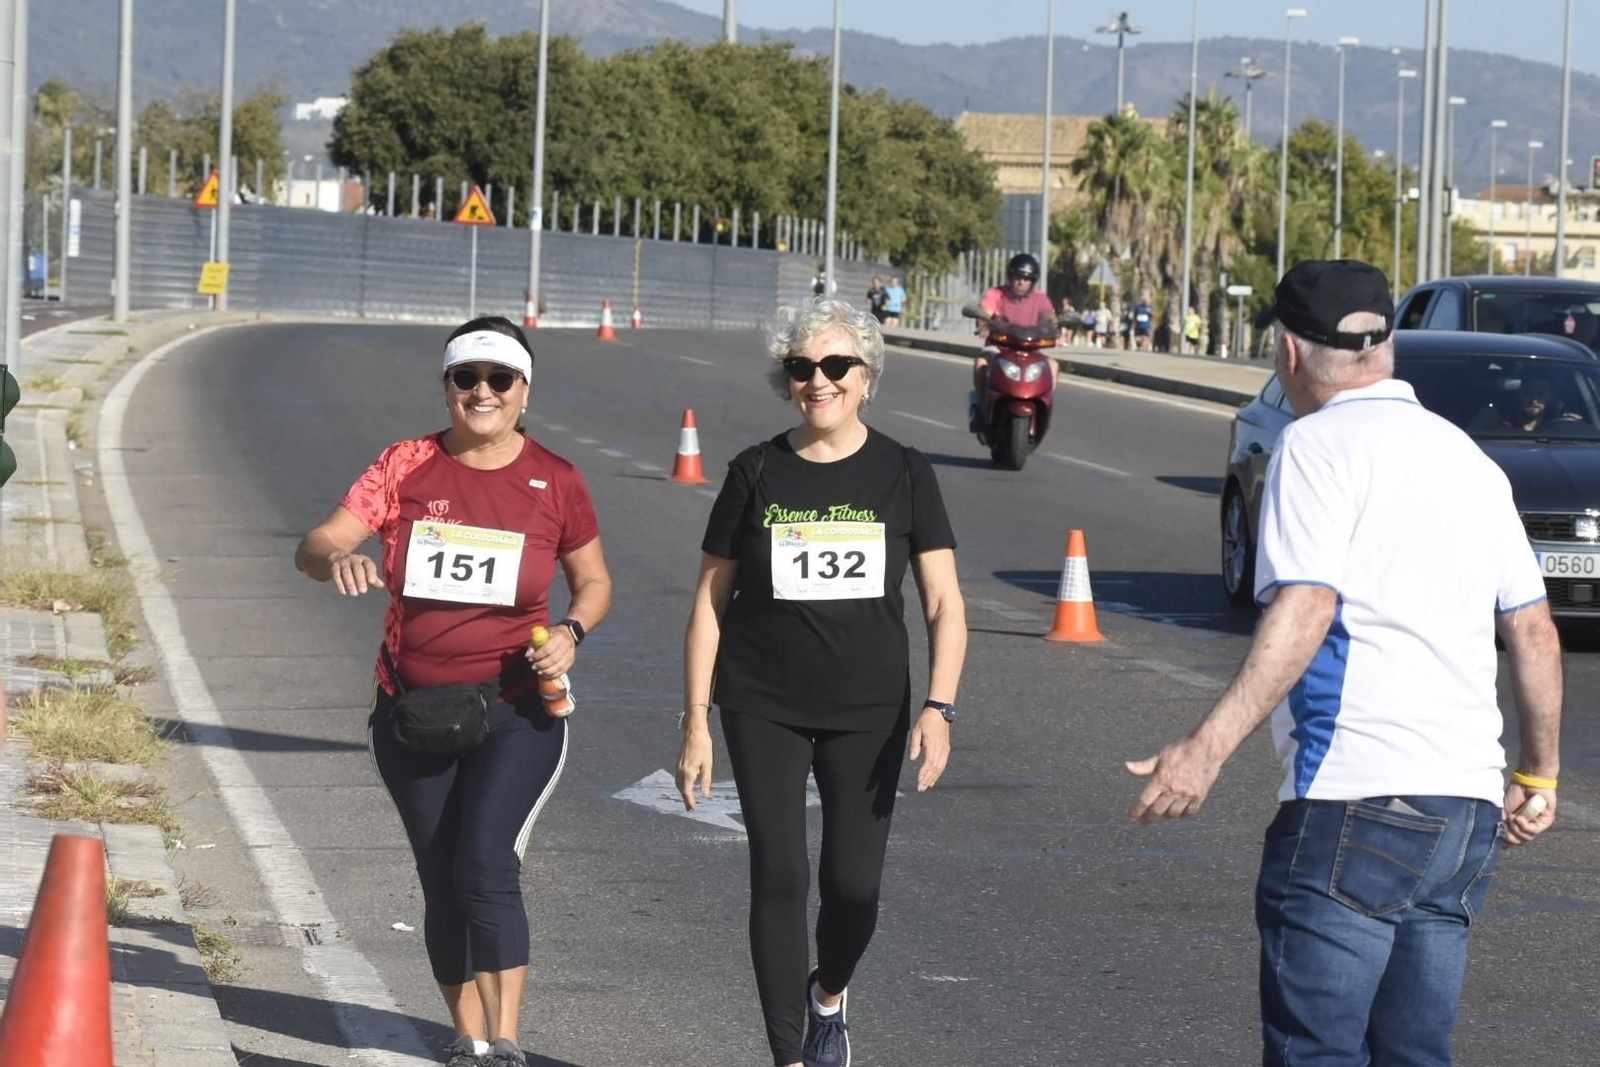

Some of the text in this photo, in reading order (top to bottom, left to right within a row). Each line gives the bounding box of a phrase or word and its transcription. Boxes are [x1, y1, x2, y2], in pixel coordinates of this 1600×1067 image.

[763, 503, 877, 528] Essence Fitness
[427, 551, 496, 584] 151
[792, 551, 866, 579] 132
[1545, 555, 1595, 574] 0560
